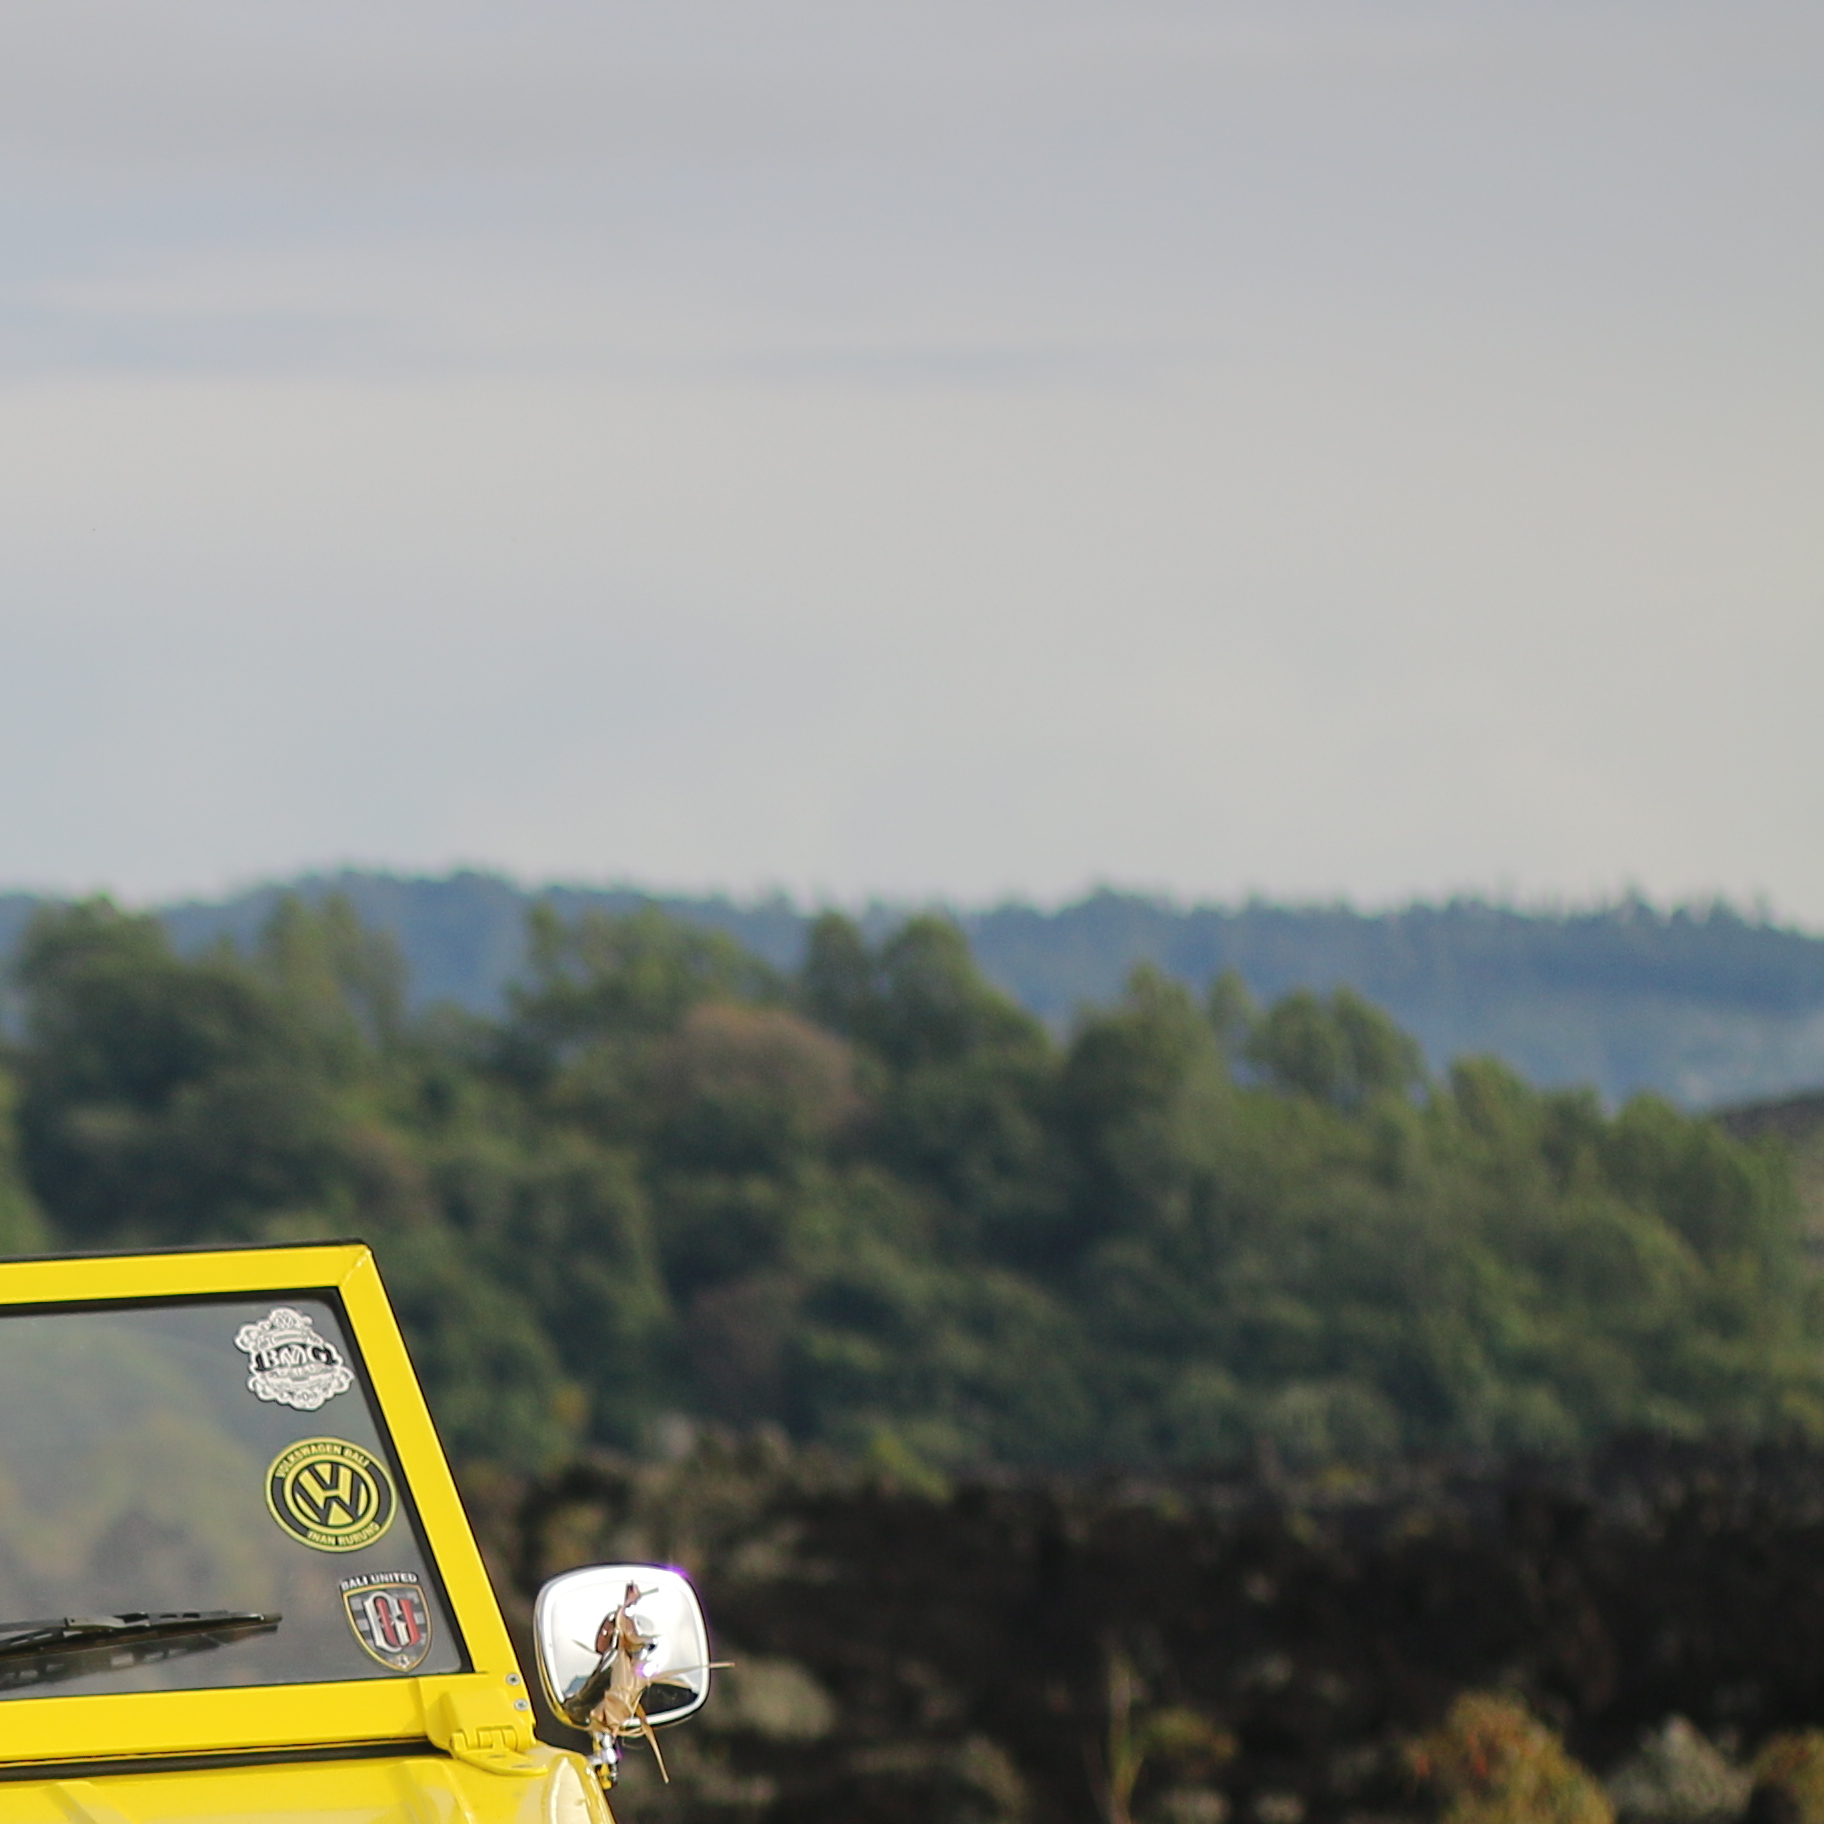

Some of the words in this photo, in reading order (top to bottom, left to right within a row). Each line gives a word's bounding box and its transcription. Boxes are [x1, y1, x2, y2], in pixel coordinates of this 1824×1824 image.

[274, 1443, 342, 1478] VOLKSWAGEN
[342, 1449, 371, 1468] BALI
[340, 1575, 369, 1592] BALI
[370, 1571, 418, 1584] UNITED
